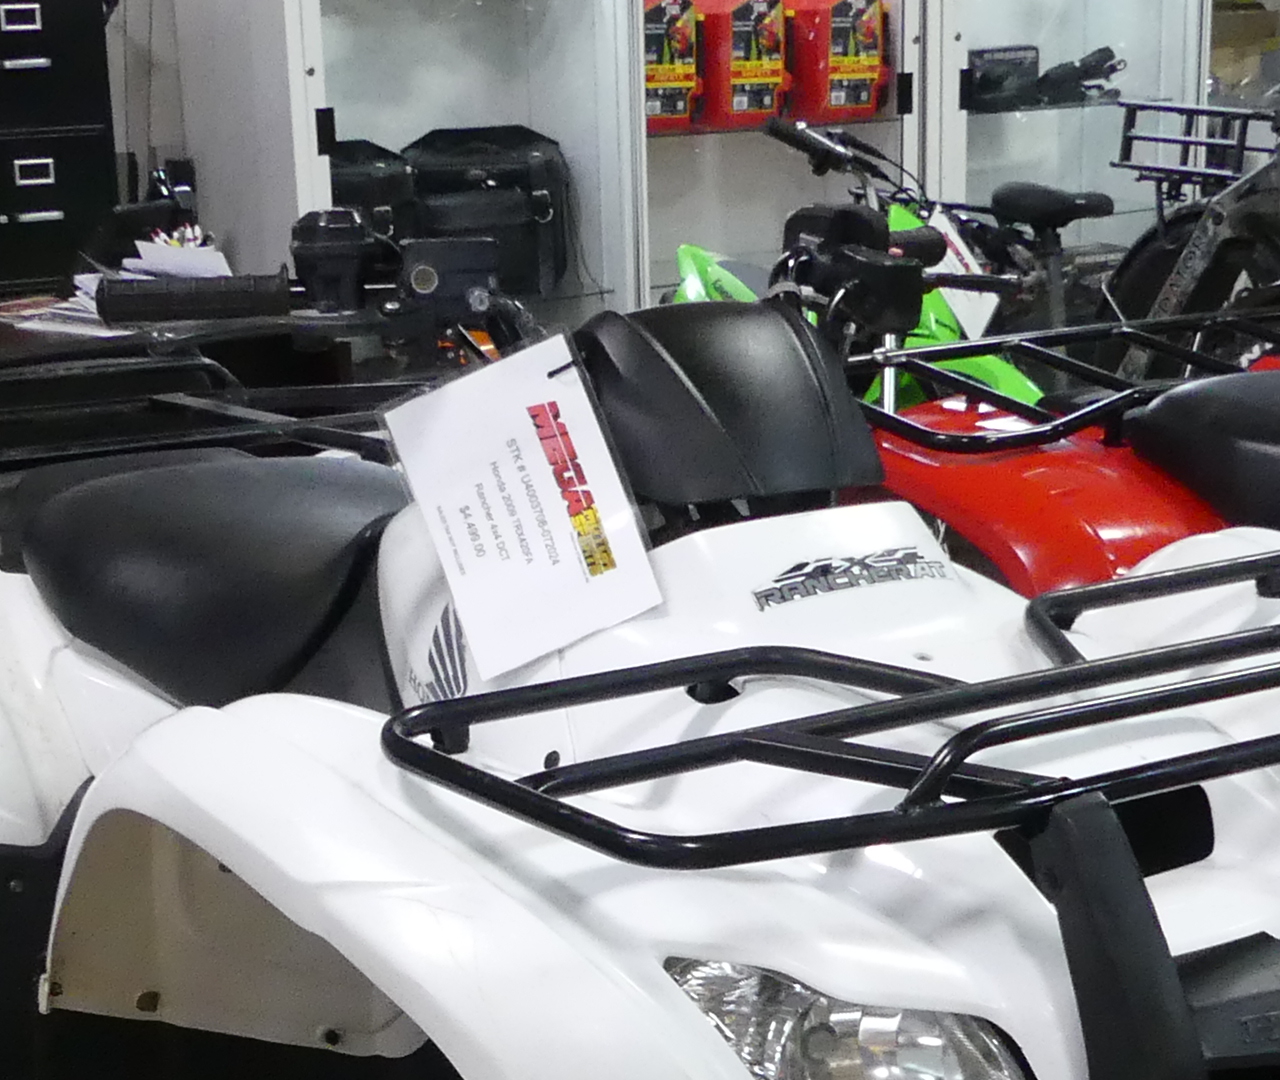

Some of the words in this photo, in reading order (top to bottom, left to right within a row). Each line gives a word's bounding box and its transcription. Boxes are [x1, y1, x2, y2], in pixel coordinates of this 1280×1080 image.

[504, 436, 524, 464] STK
[525, 400, 596, 518] MEGA
[473, 481, 495, 523] Rancher
[488, 460, 507, 493] Honda
[501, 492, 518, 518] 2009
[488, 522, 502, 541] 4x4
[494, 540, 510, 562] DCT
[751, 565, 911, 612] RANCHER
